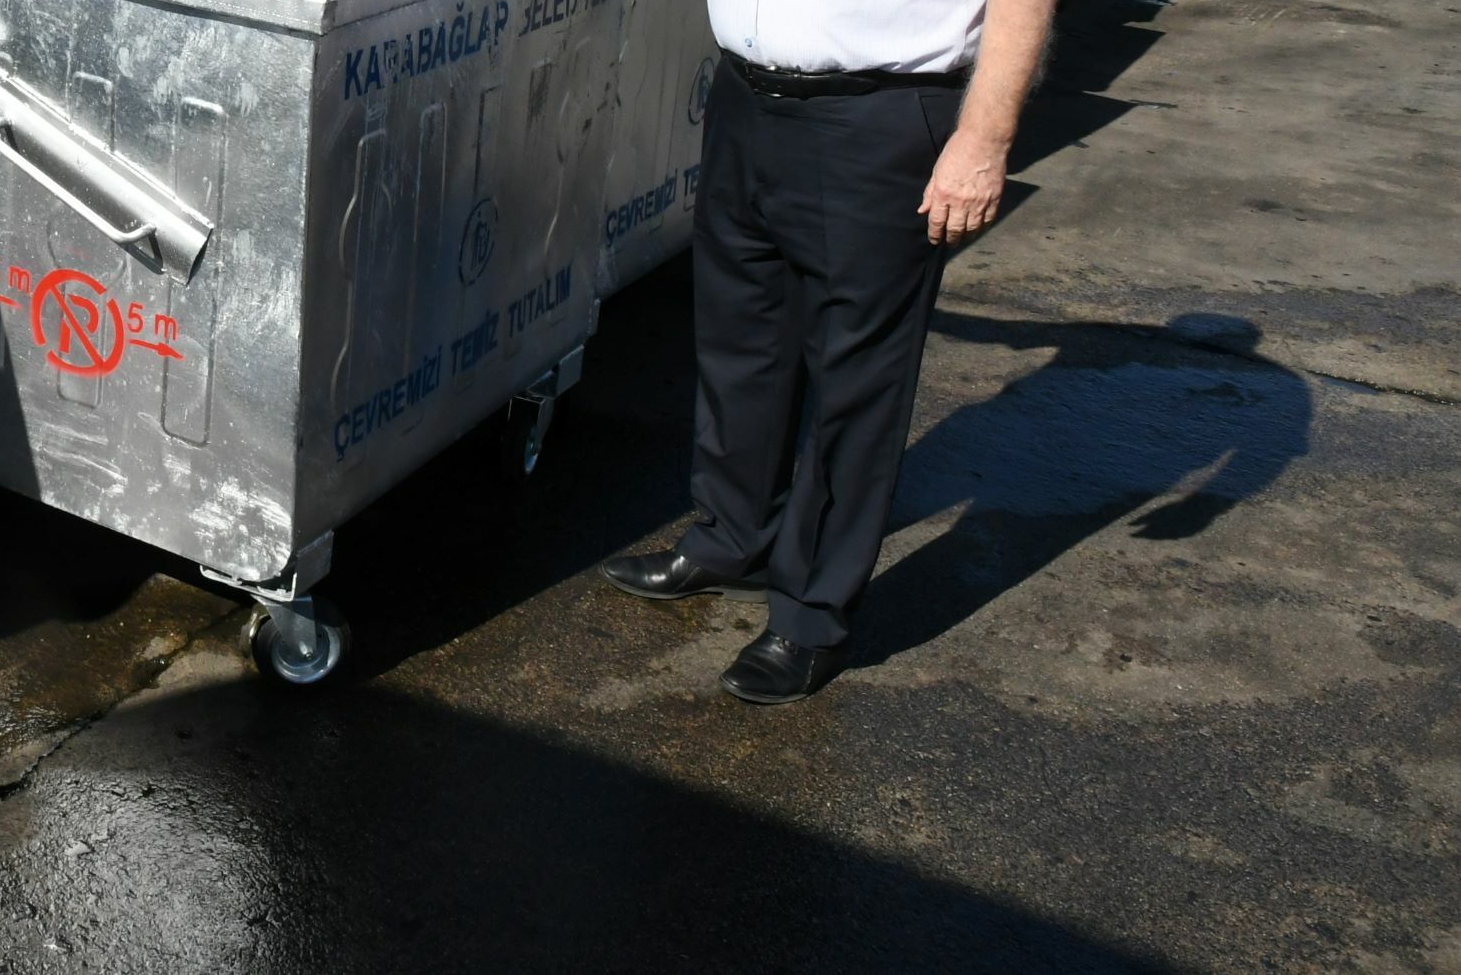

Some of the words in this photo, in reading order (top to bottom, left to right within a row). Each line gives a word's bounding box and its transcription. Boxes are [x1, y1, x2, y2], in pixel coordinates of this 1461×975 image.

[127, 301, 145, 334] 5
[334, 344, 442, 463] ÇEVREMİZİ
[451, 309, 500, 375] TEMİZ
[508, 262, 572, 338] TUTALIM
